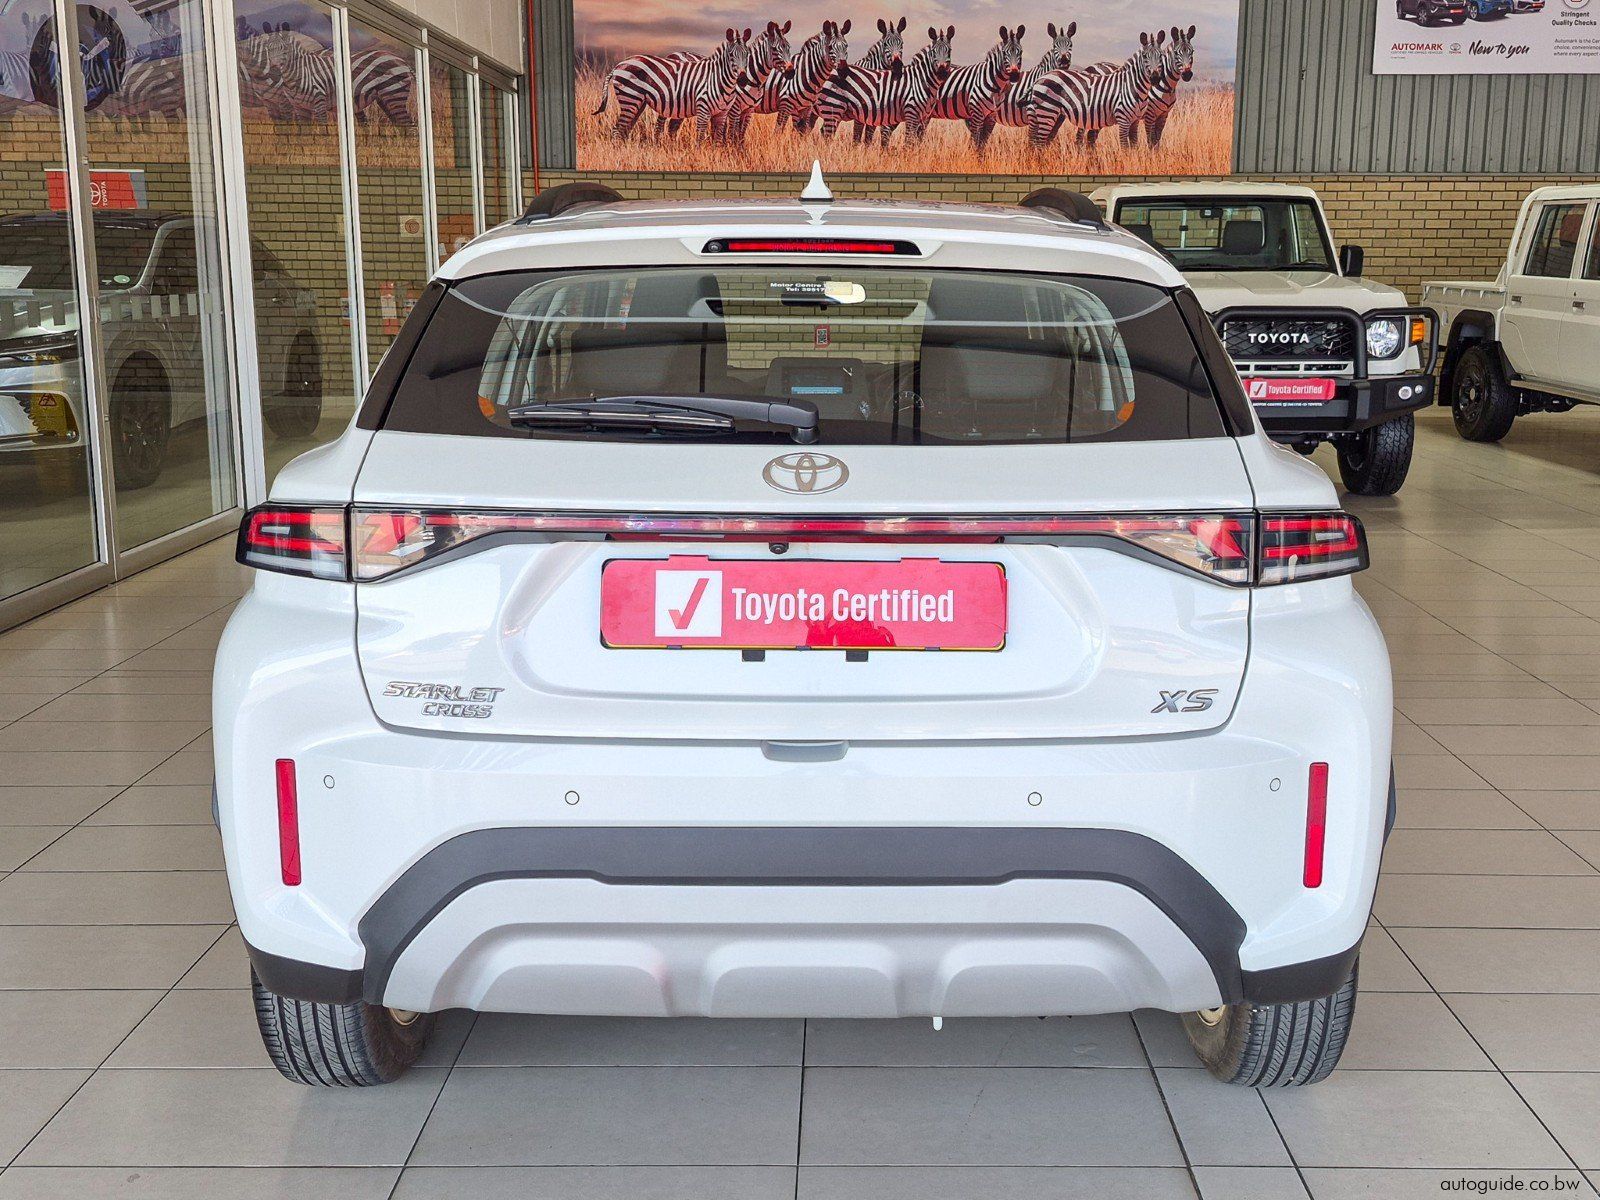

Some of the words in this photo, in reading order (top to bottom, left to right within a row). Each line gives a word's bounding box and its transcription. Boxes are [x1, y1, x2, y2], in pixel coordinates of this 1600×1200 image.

[1391, 43, 1443, 51] AUTOMARK
[1468, 40, 1495, 56] New
[1506, 46, 1530, 58] you
[1248, 333, 1310, 344] TOYOTA
[1268, 385, 1291, 395] Toyota
[1291, 384, 1323, 394] Certified
[731, 587, 825, 625] Toyota
[832, 588, 955, 623] Certified
[382, 681, 505, 702] STARLET
[1150, 688, 1219, 713] XS
[421, 702, 494, 718] CROSS
